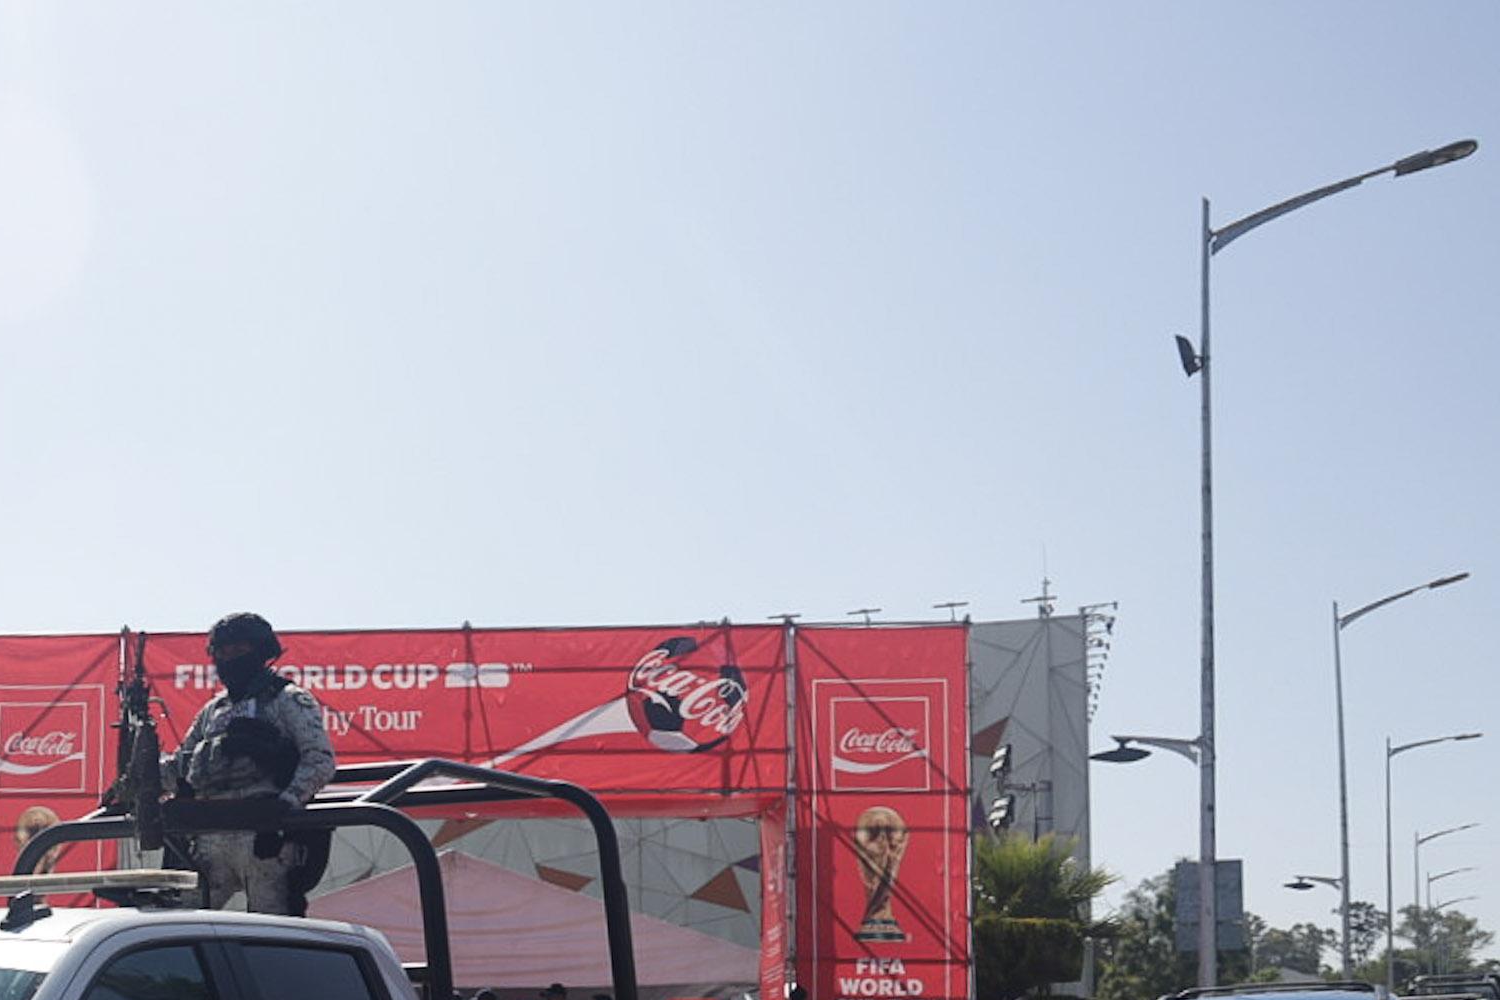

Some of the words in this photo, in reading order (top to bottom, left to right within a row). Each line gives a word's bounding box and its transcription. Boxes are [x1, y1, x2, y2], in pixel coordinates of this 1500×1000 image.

[174, 664, 219, 690] FIF
[270, 664, 367, 690] ORLD
[372, 664, 440, 690] CUP
[359, 706, 422, 731] Tour
[856, 957, 906, 975] FIFA
[839, 977, 923, 996] WORLD
